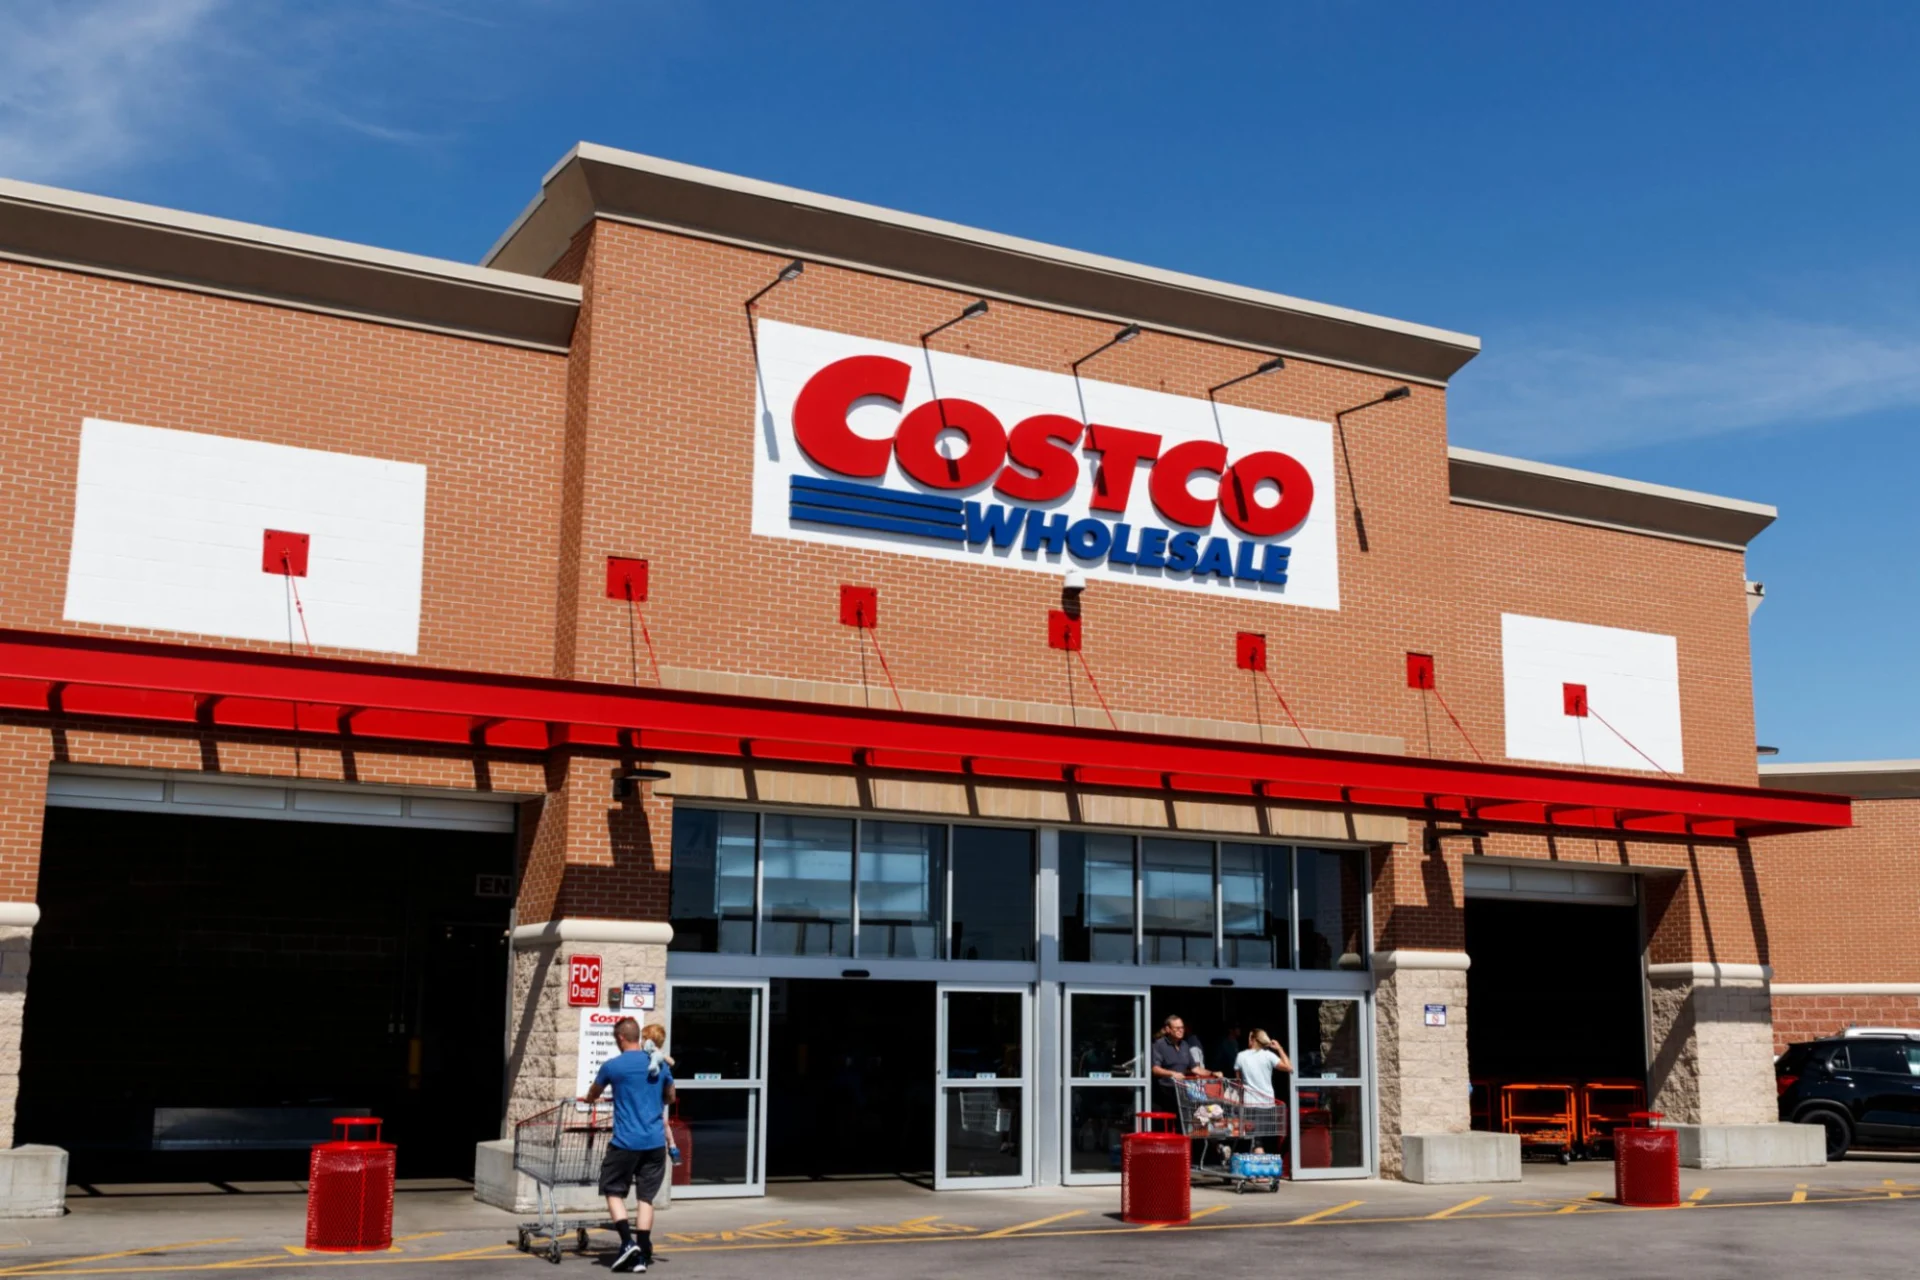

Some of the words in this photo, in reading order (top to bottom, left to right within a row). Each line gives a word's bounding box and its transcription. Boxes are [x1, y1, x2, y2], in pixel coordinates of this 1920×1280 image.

[792, 354, 1314, 537] COSTCO
[964, 500, 1292, 586] WHOLESALE
[572, 963, 599, 982] FDC
[572, 983, 579, 997] D
[580, 987, 596, 998] SIDE
